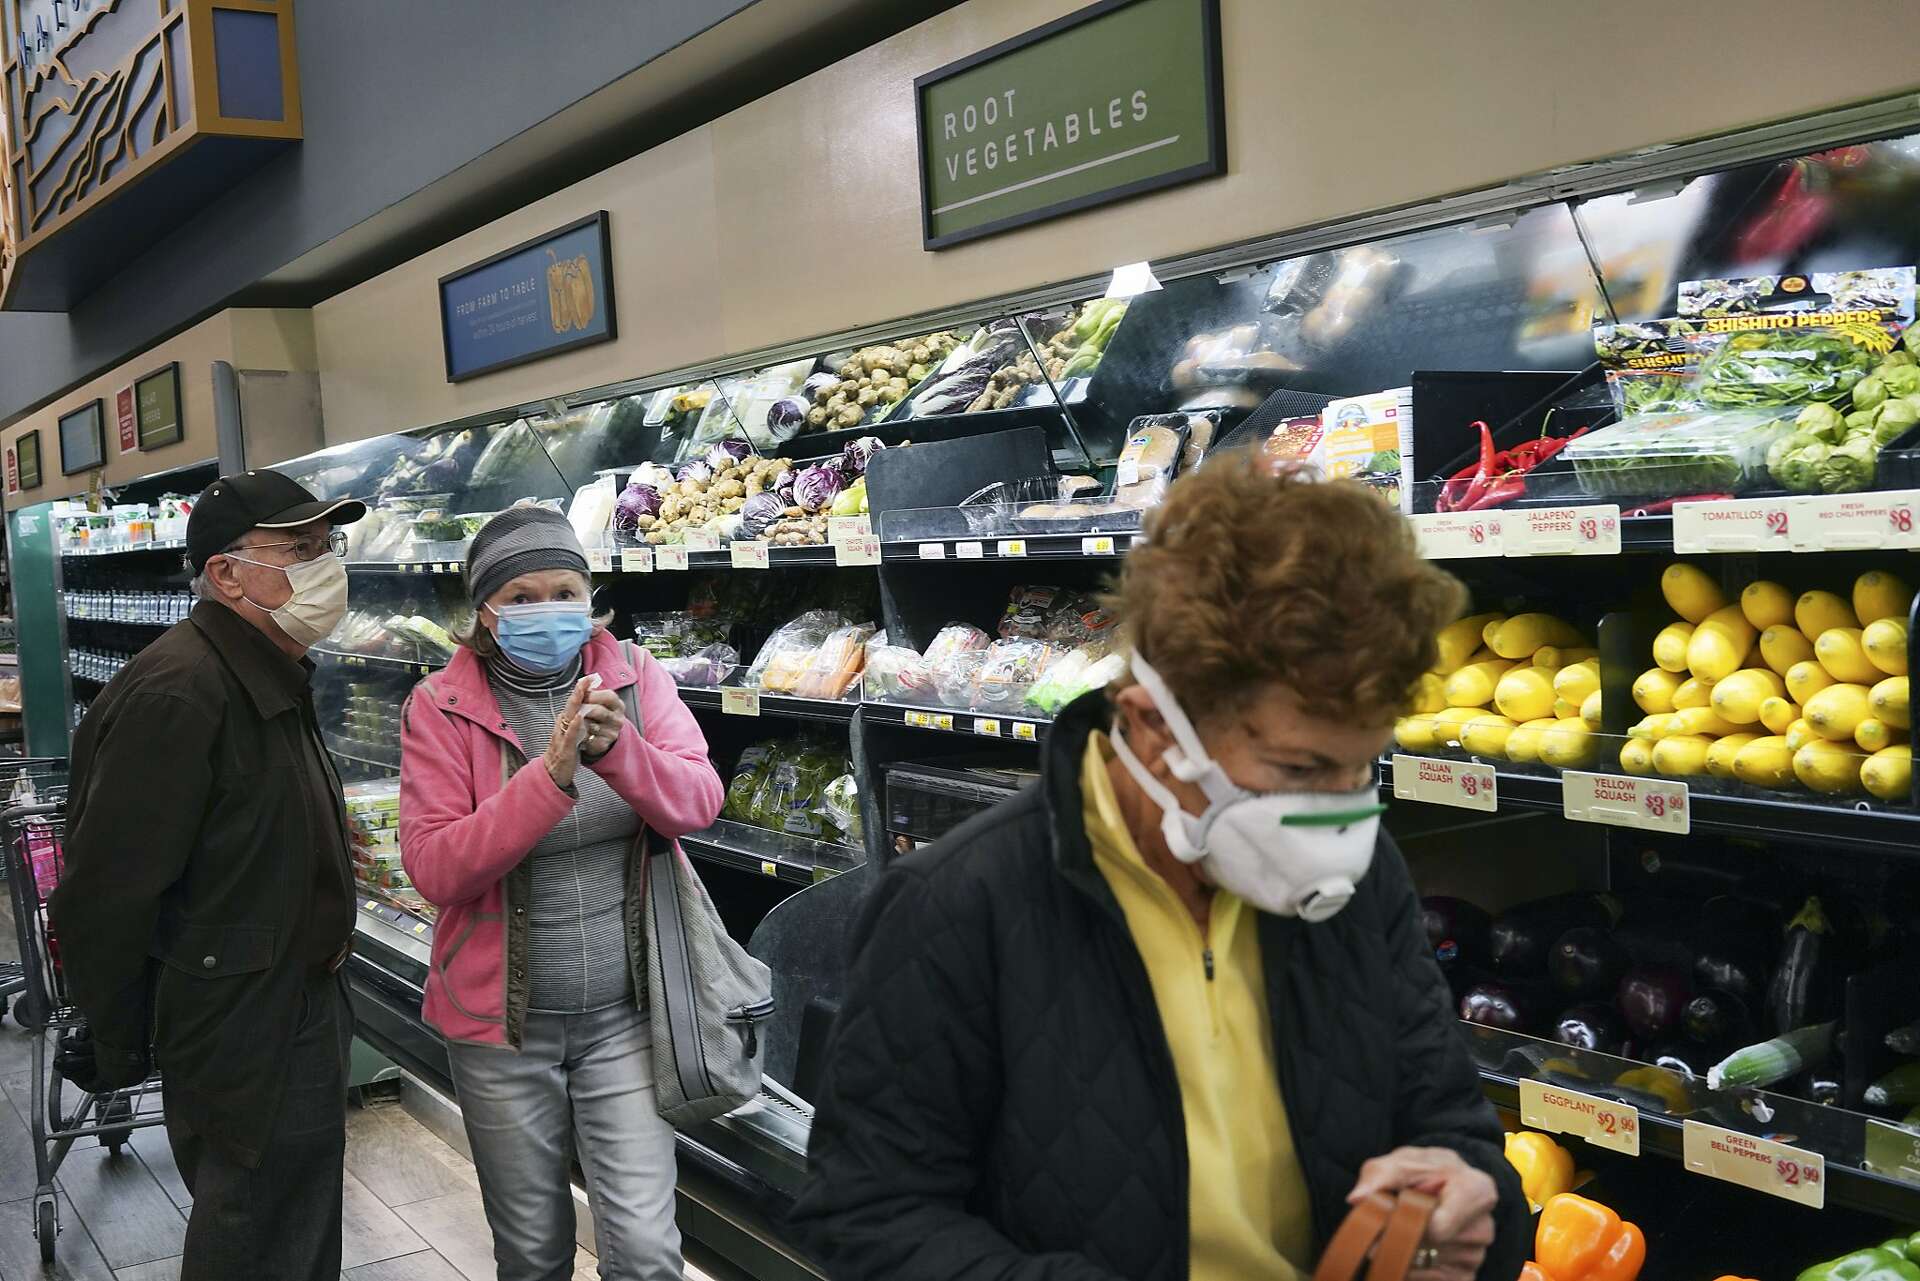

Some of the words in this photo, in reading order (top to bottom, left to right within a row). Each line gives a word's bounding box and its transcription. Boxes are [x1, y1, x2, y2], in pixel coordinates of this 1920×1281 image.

[945, 89, 1016, 140] ROOT
[945, 89, 1148, 182] VEGETABLES
[456, 301, 475, 316] FROM
[478, 292, 497, 309] FARM
[500, 287, 510, 302] TO
[512, 277, 536, 296] TABLE
[1707, 315, 1794, 332] SHISHITO
[1796, 310, 1882, 328] PEPPERS
[1532, 522, 1572, 532] PEPPERS
[1579, 519, 1597, 539] $3
[1601, 518, 1616, 530] 99
[1701, 510, 1764, 521] TOMATILLOS
[1766, 511, 1788, 534] $2
[1835, 510, 1854, 518] CHILI
[1855, 509, 1888, 517] PEPPERS
[1889, 508, 1913, 532] $8
[1469, 524, 1485, 544] $8
[1420, 761, 1451, 773] ITALIAN
[1419, 771, 1453, 784] SQUASH
[1460, 774, 1477, 796] $3
[1594, 778, 1635, 790] YELLOW
[1594, 789, 1636, 803] SQUASH
[1645, 794, 1665, 817] $3
[1669, 795, 1684, 810] 99
[1543, 1092, 1596, 1114] EGGPLANT
[1597, 1111, 1617, 1135] $2
[1621, 1117, 1635, 1132] 99
[1726, 1135, 1757, 1150] GREEN
[1711, 1140, 1731, 1153] BELL
[1733, 1147, 1772, 1164] PEPPERS
[1777, 1159, 1799, 1185] $2
[1803, 1166, 1820, 1183] 99
